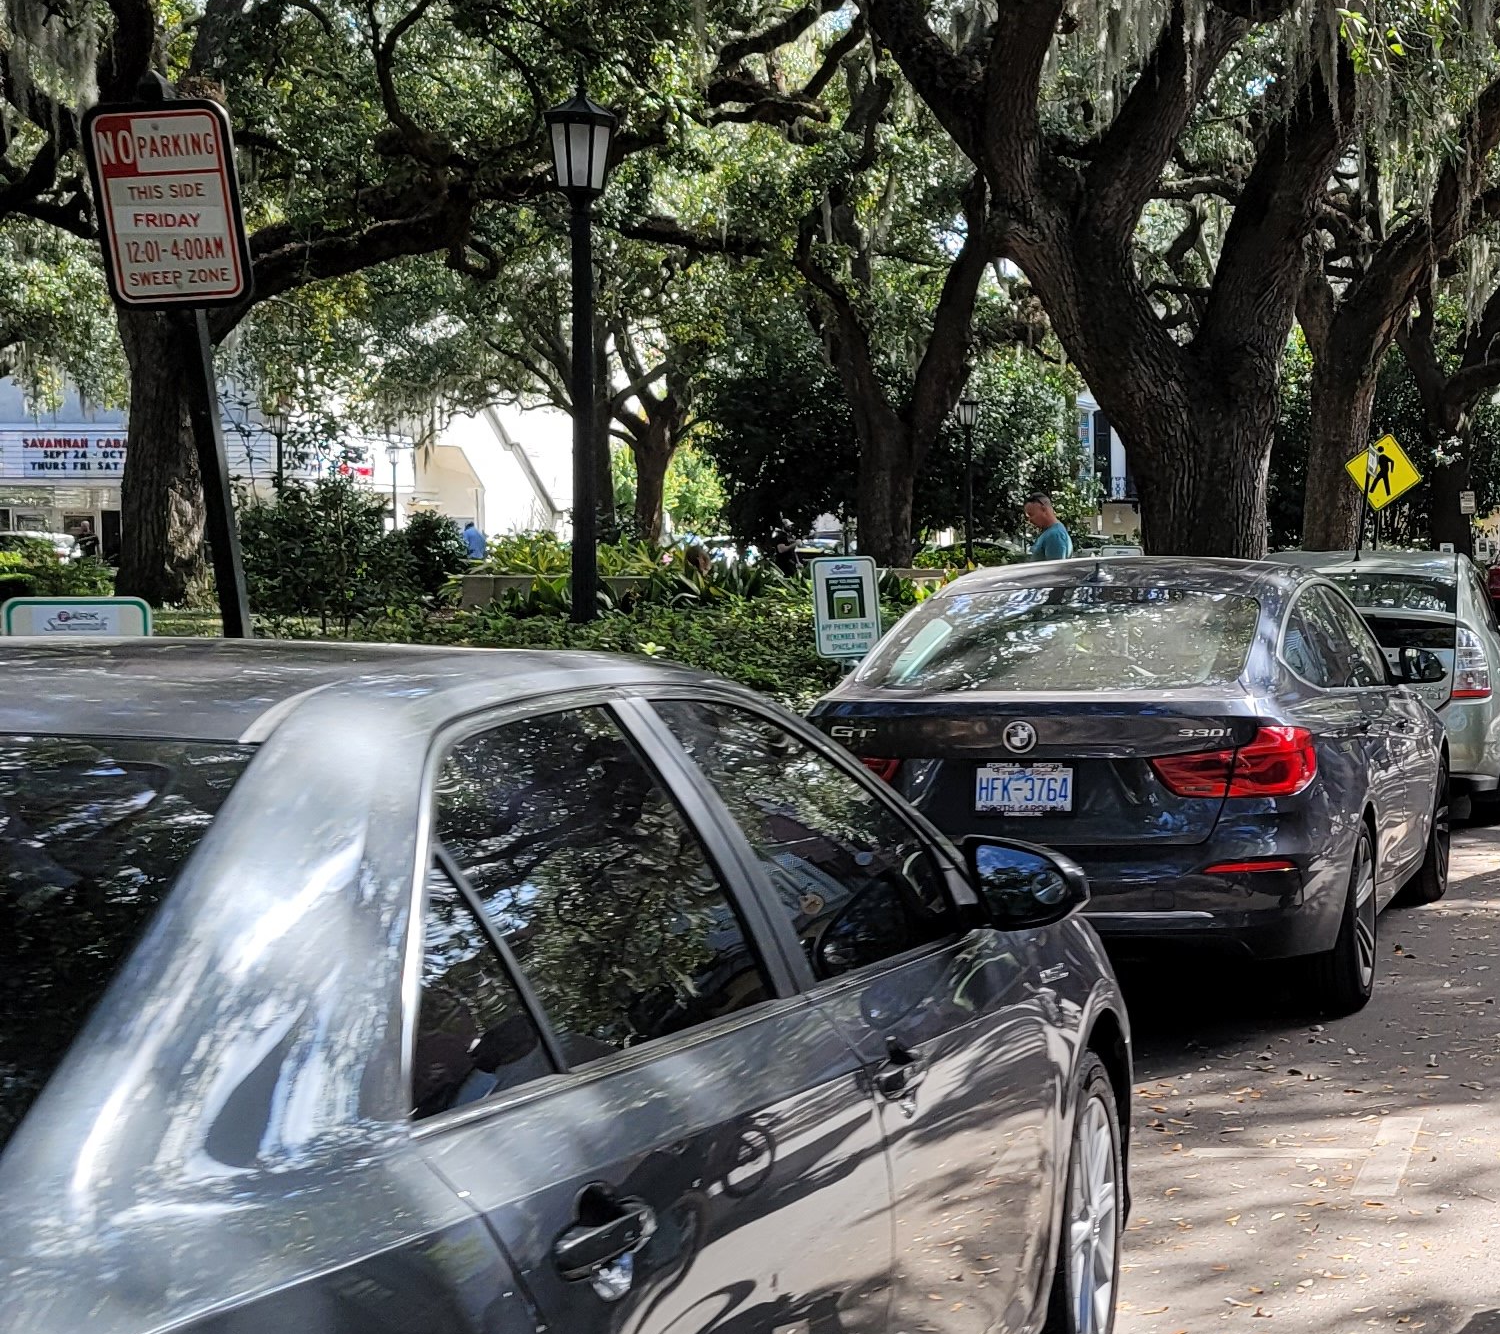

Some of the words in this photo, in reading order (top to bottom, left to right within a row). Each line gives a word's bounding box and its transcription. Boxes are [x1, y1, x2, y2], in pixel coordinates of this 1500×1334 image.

[96, 130, 134, 165] NO
[137, 132, 215, 158] PARKING
[127, 184, 164, 201] THIS
[169, 182, 206, 198] SIDE
[132, 213, 201, 228] FRIDAY
[129, 270, 183, 287] SWEEP
[188, 268, 231, 284] ZONE
[22, 438, 89, 448] SAVANNAH
[43, 450, 68, 459] SEPT
[73, 450, 88, 459] 24
[102, 450, 124, 459] OCT
[30, 462, 67, 471] THURS
[73, 462, 91, 471] FRI
[97, 462, 119, 471] SAT
[831, 725, 877, 738] GT
[978, 777, 1068, 802] HFK-3764
